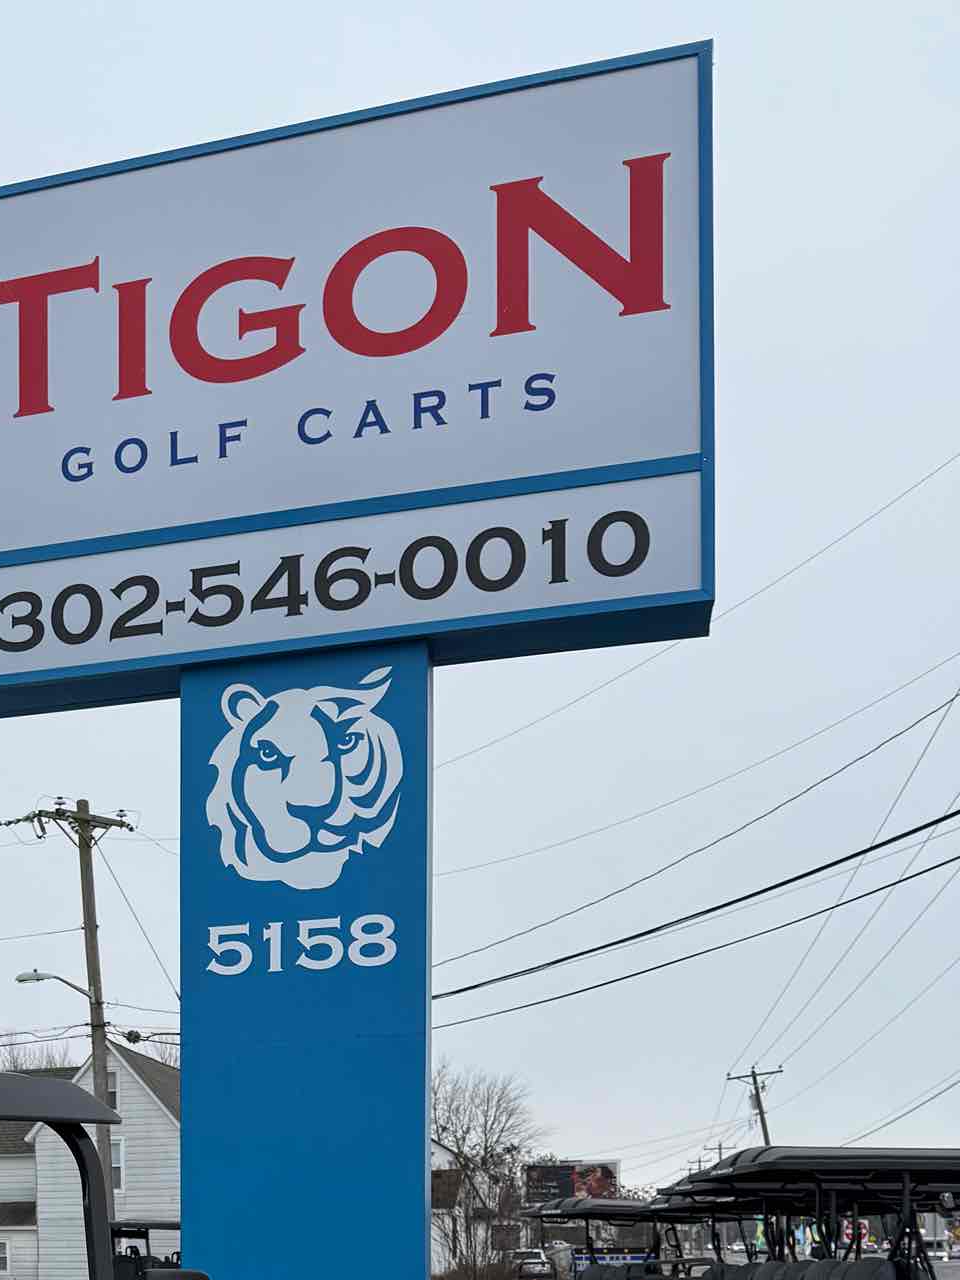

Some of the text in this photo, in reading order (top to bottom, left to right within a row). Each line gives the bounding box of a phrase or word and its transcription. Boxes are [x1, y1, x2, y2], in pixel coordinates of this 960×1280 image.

[60, 373, 557, 482] GOLF CARTS
[206, 914, 397, 976] 5158
